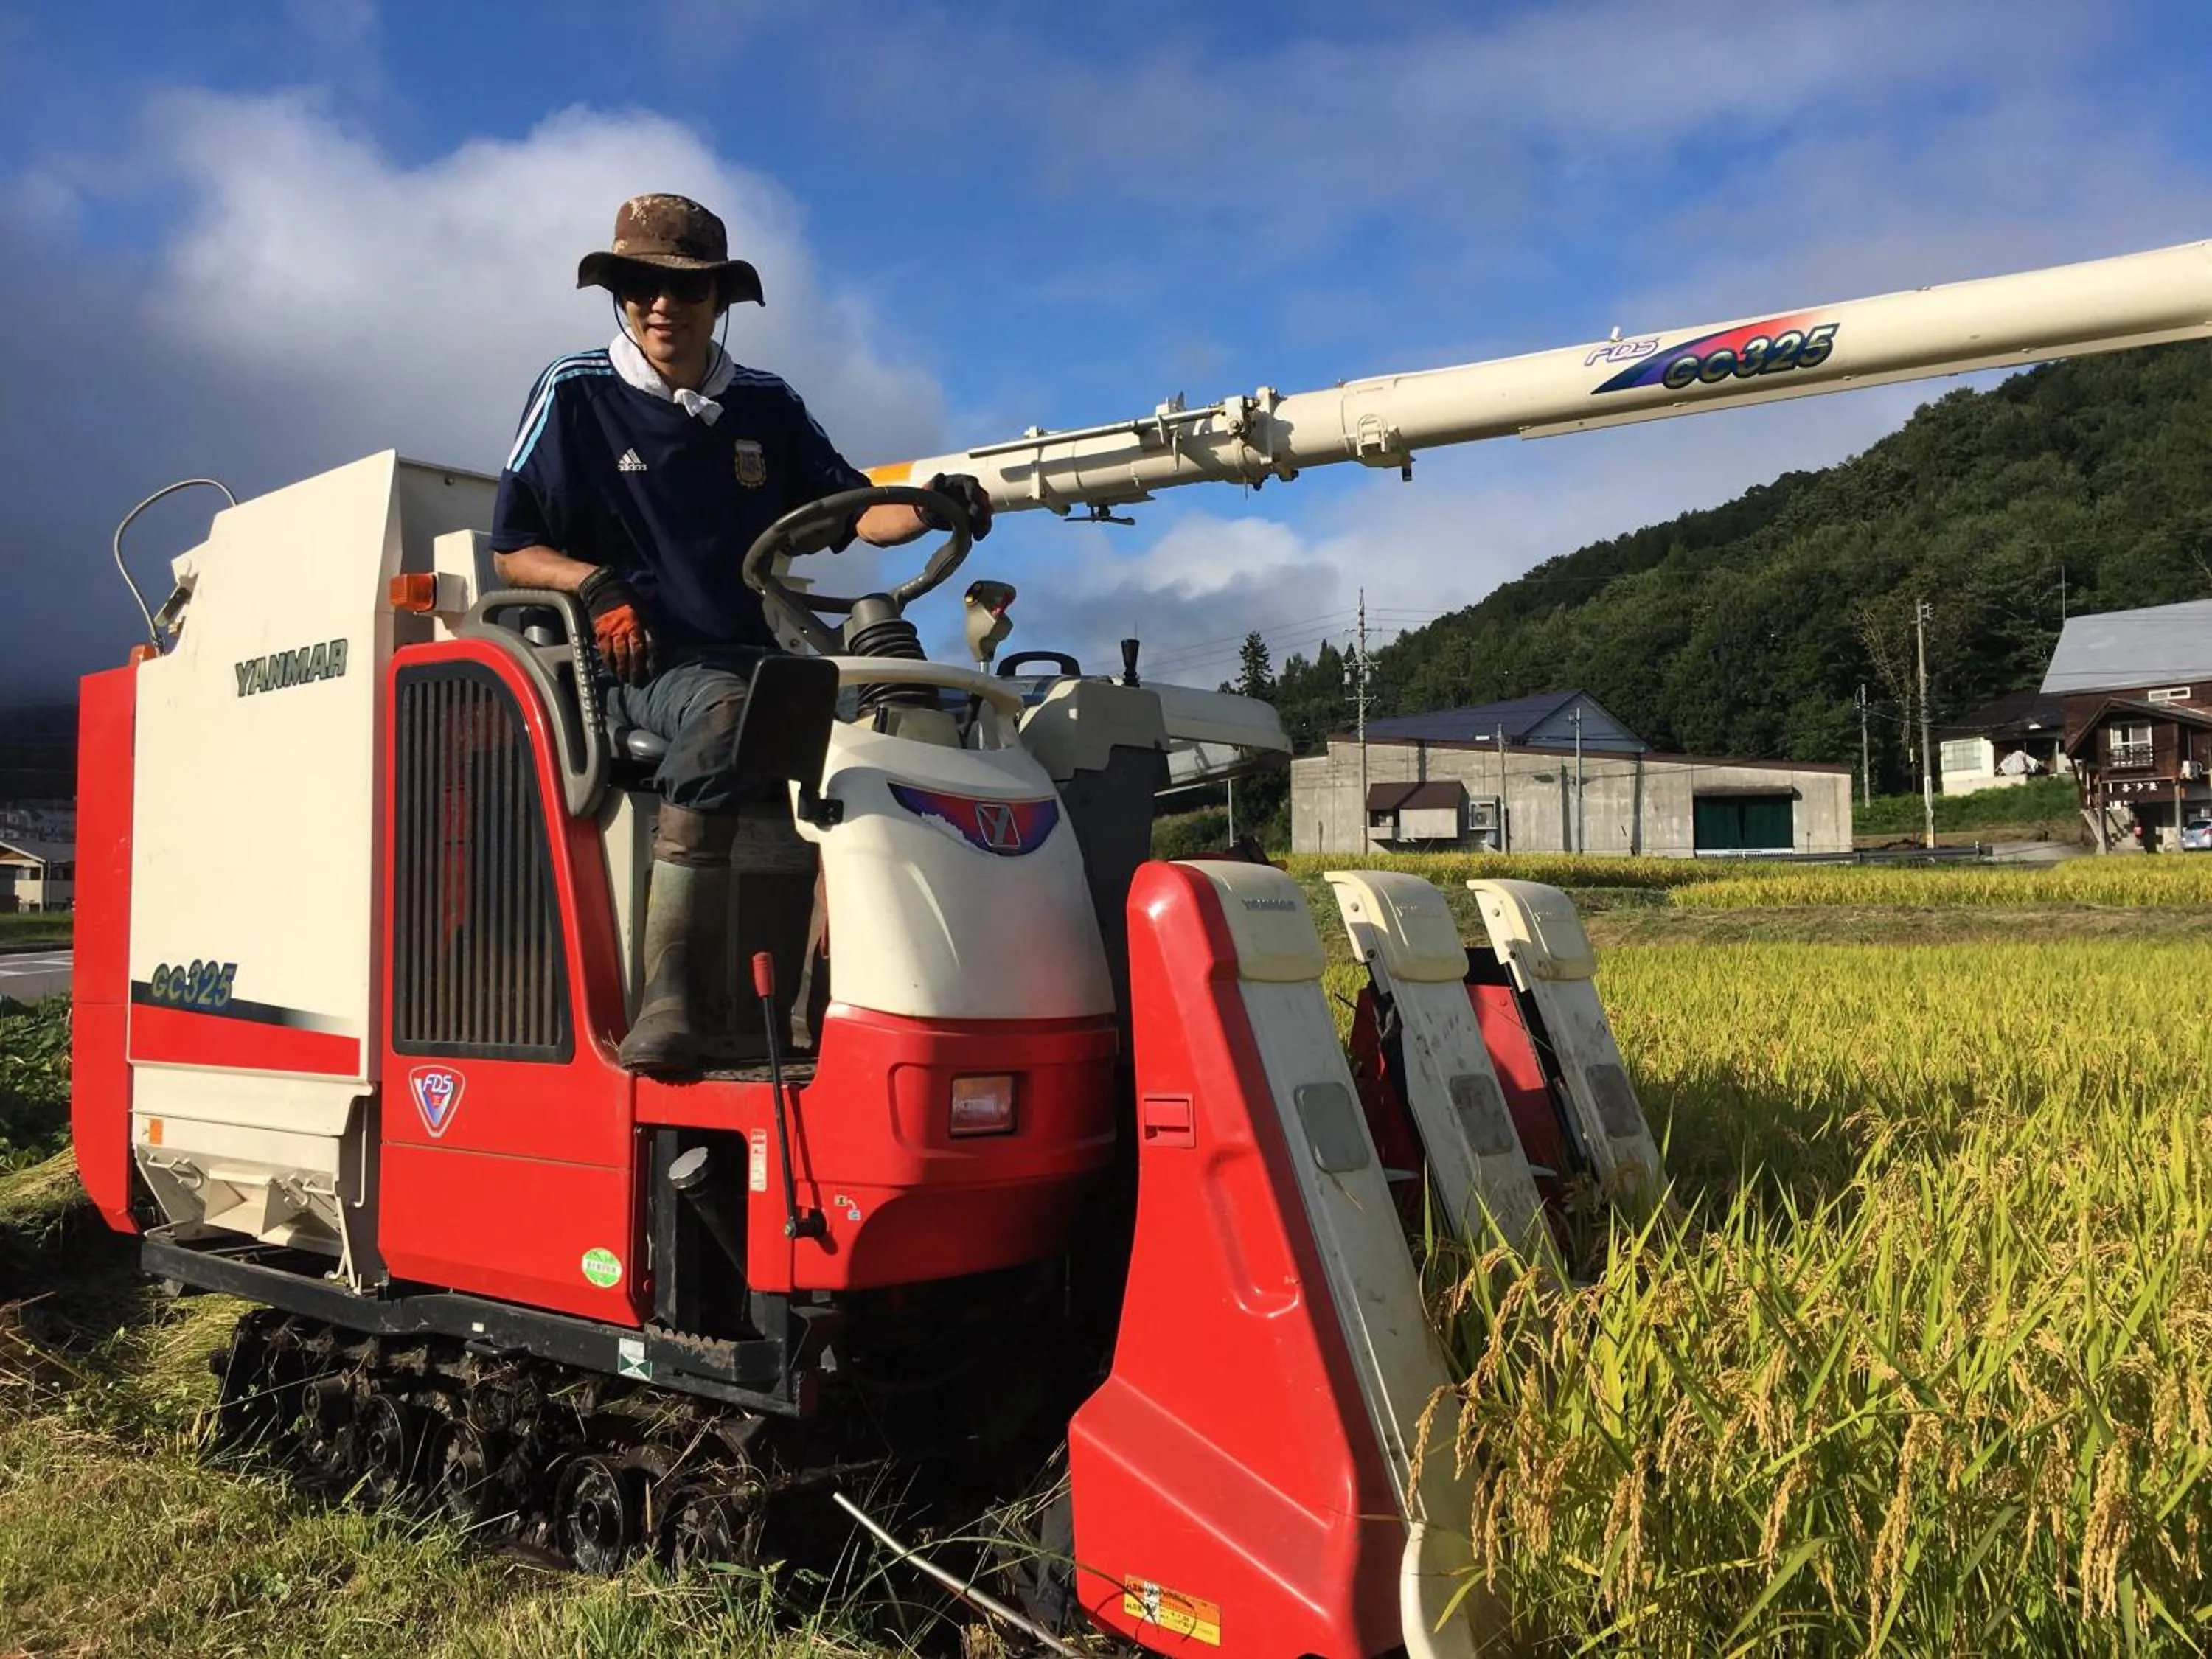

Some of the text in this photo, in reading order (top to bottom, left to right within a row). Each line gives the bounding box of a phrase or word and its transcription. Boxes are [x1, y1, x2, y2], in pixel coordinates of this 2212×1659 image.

[1584, 338, 1660, 366] FDS
[1662, 323, 1840, 389] GC325
[235, 638, 348, 697] YANMAR
[152, 959, 237, 1007] GC325
[422, 1074, 452, 1094] FDS
